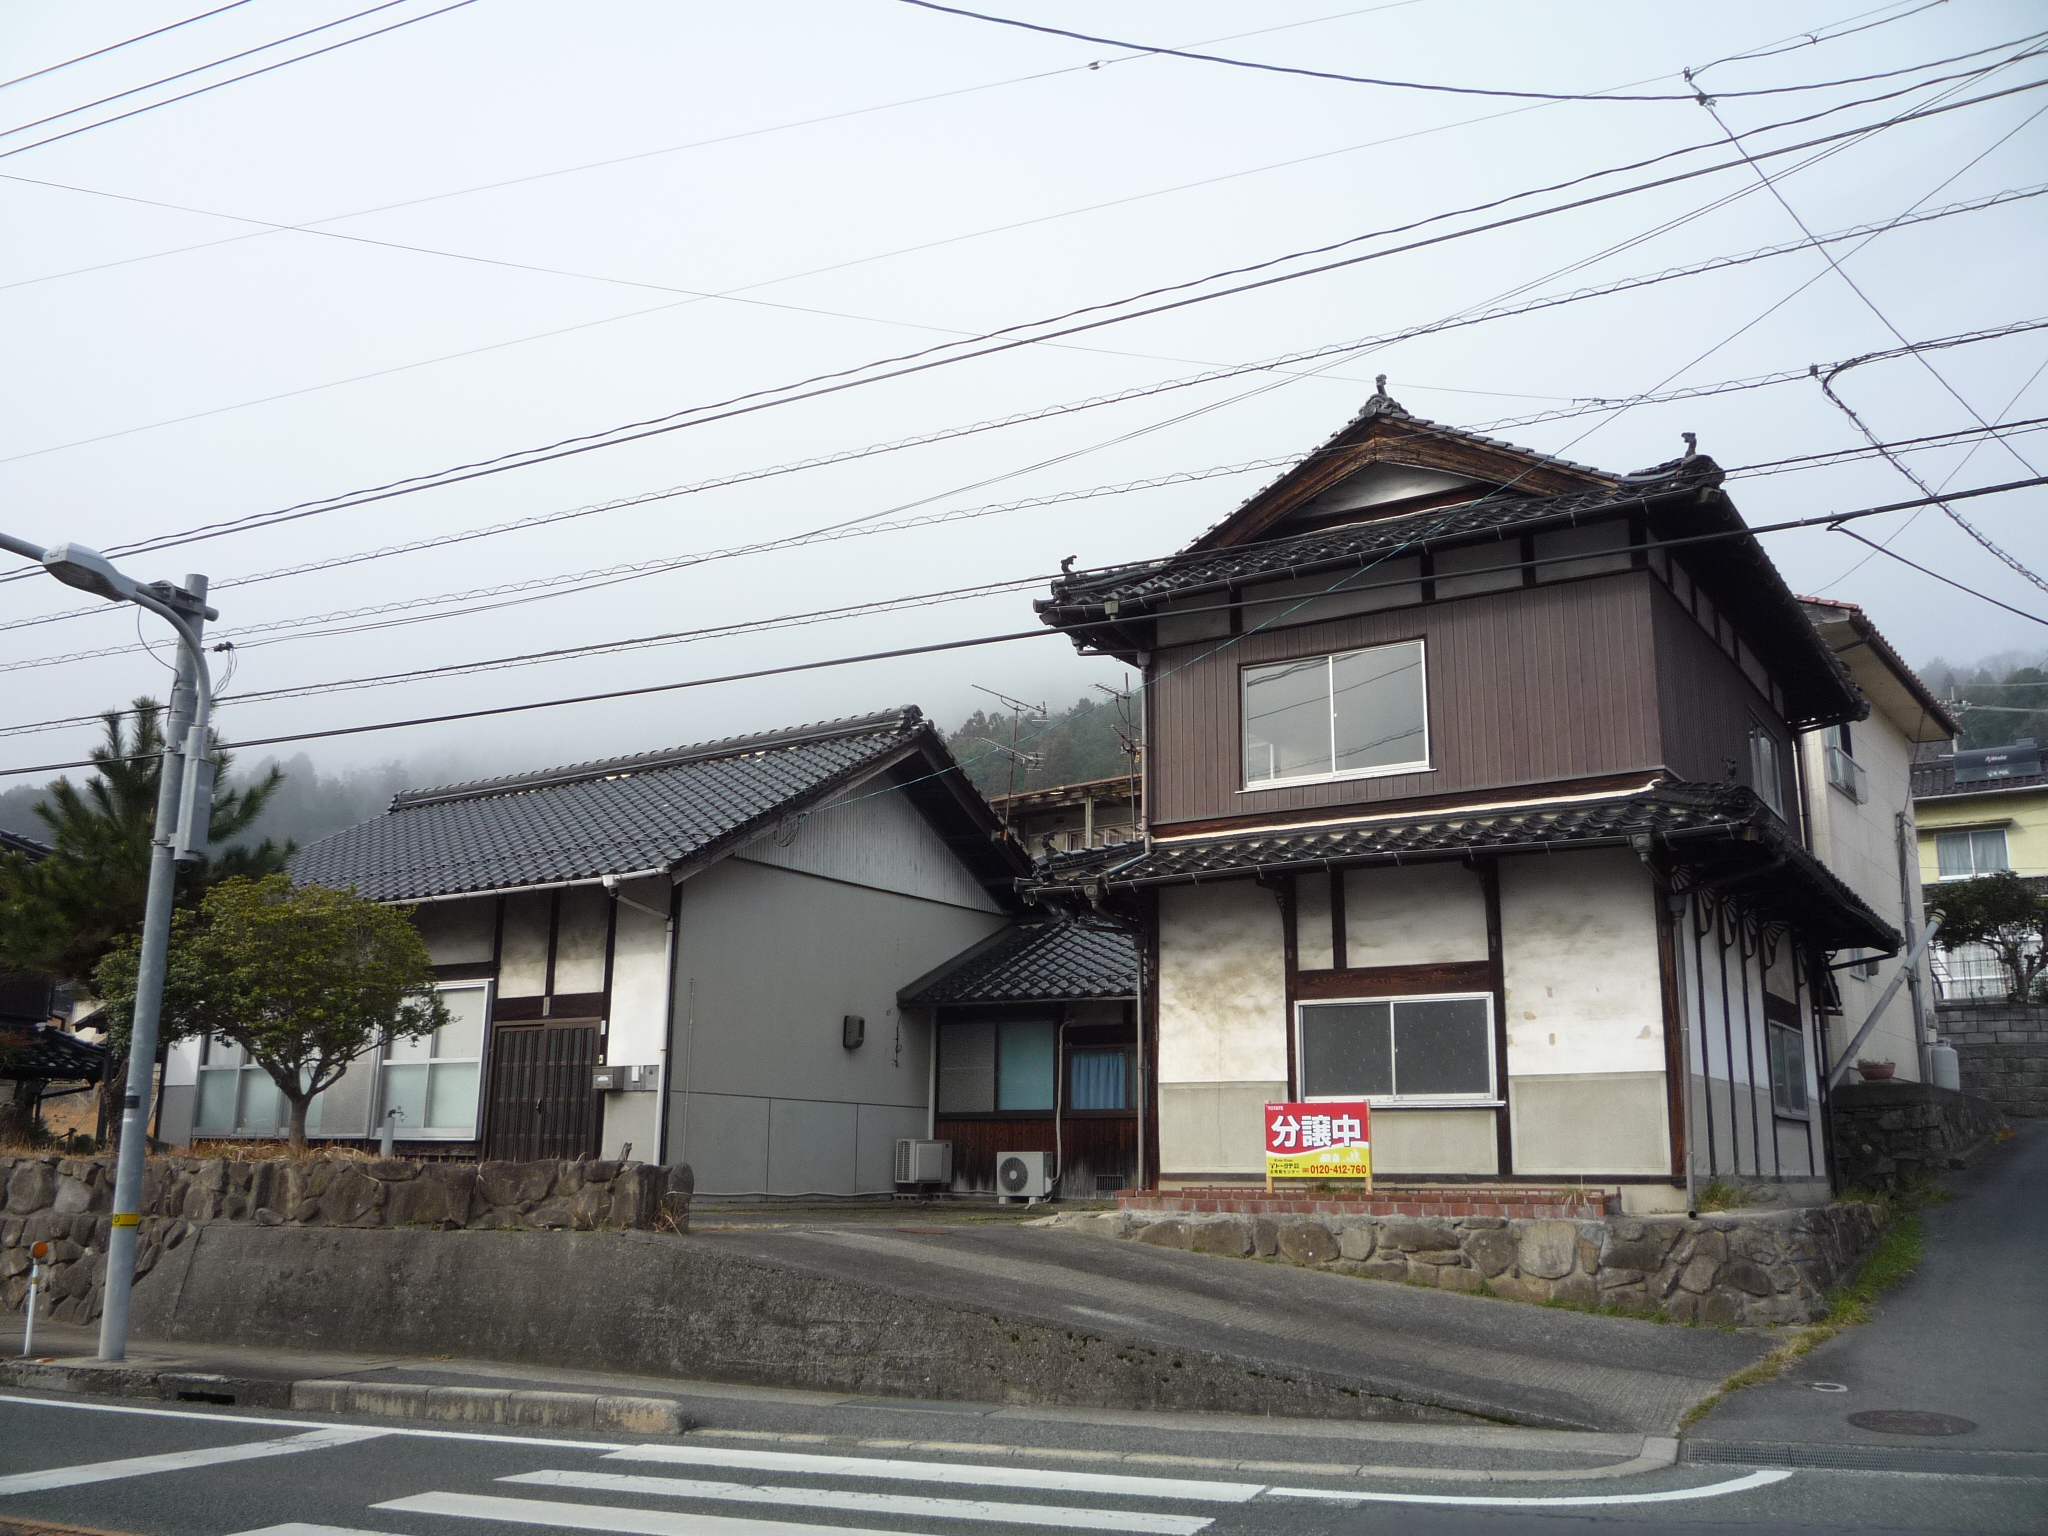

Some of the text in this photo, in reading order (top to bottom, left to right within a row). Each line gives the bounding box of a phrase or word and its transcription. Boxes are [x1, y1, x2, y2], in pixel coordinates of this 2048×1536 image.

[1271, 1114, 1361, 1148] 分譲中
[1310, 1164, 1367, 1174] 0120-412-760
